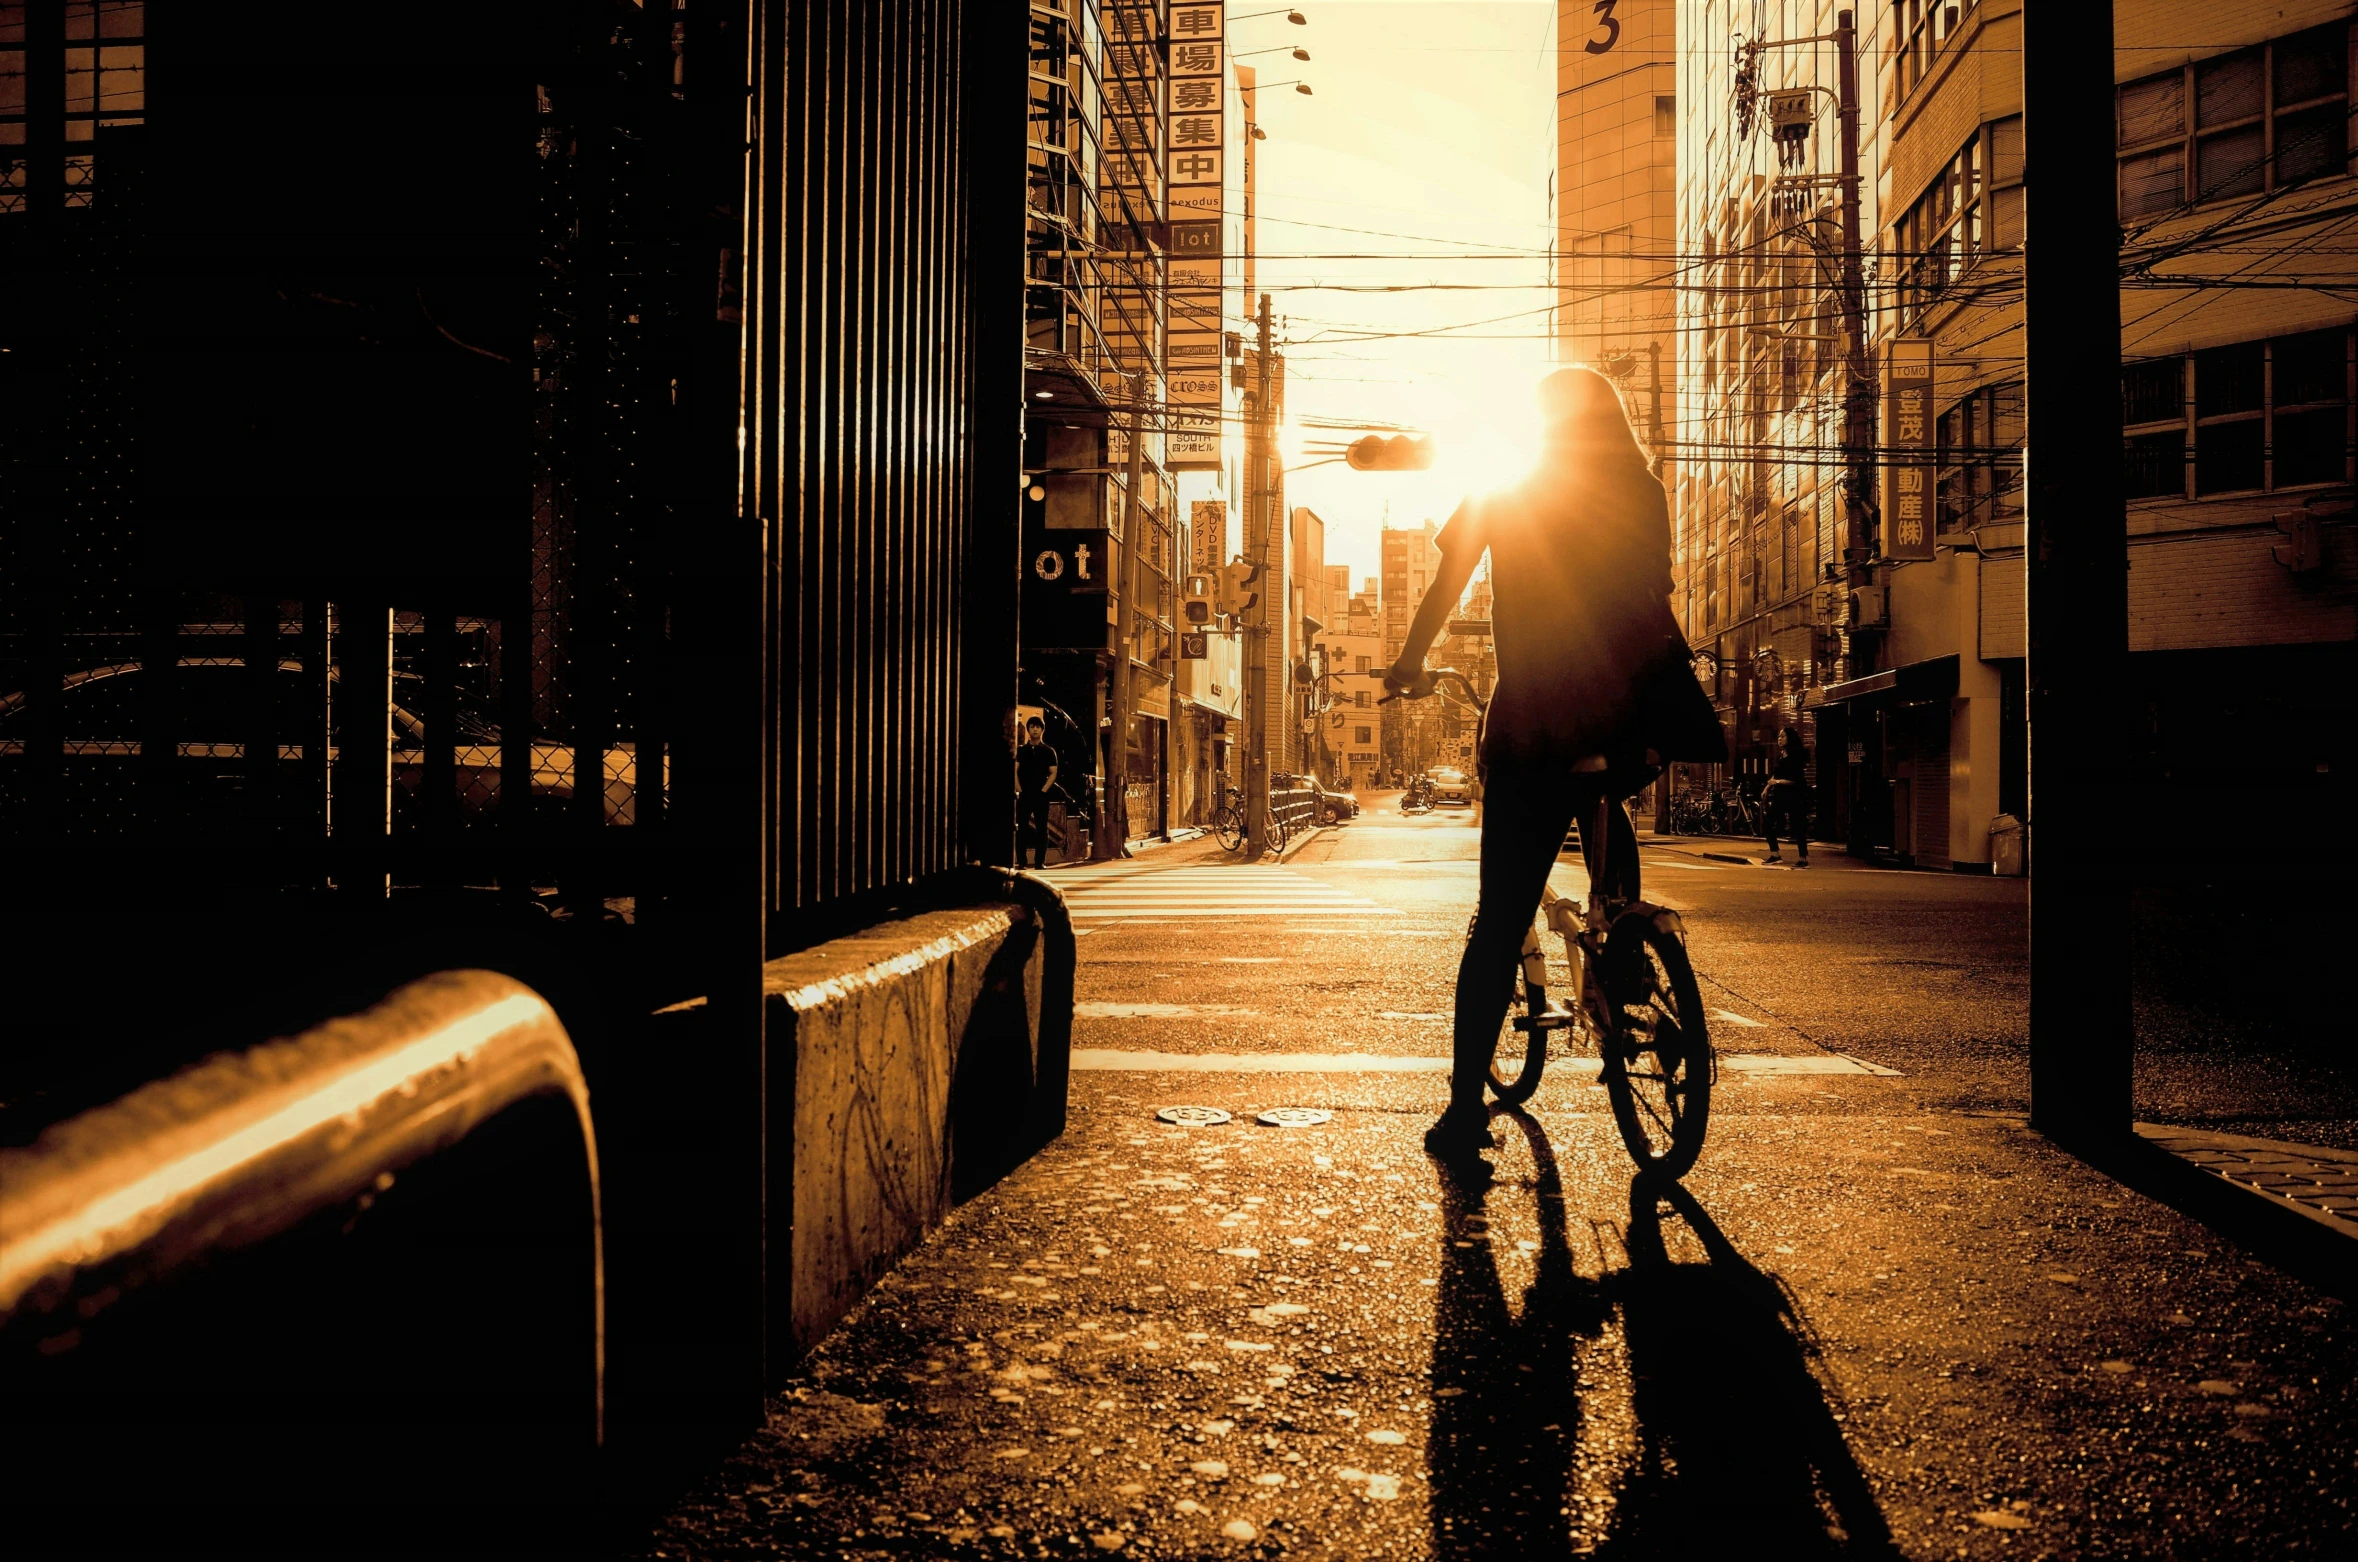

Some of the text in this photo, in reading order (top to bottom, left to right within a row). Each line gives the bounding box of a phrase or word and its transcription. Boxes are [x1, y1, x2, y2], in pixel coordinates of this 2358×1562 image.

[1585, 0, 1619, 54] 3
[1175, 9, 1216, 179] 車場募集中
[1172, 443, 1215, 452] 四ツ橋ビル
